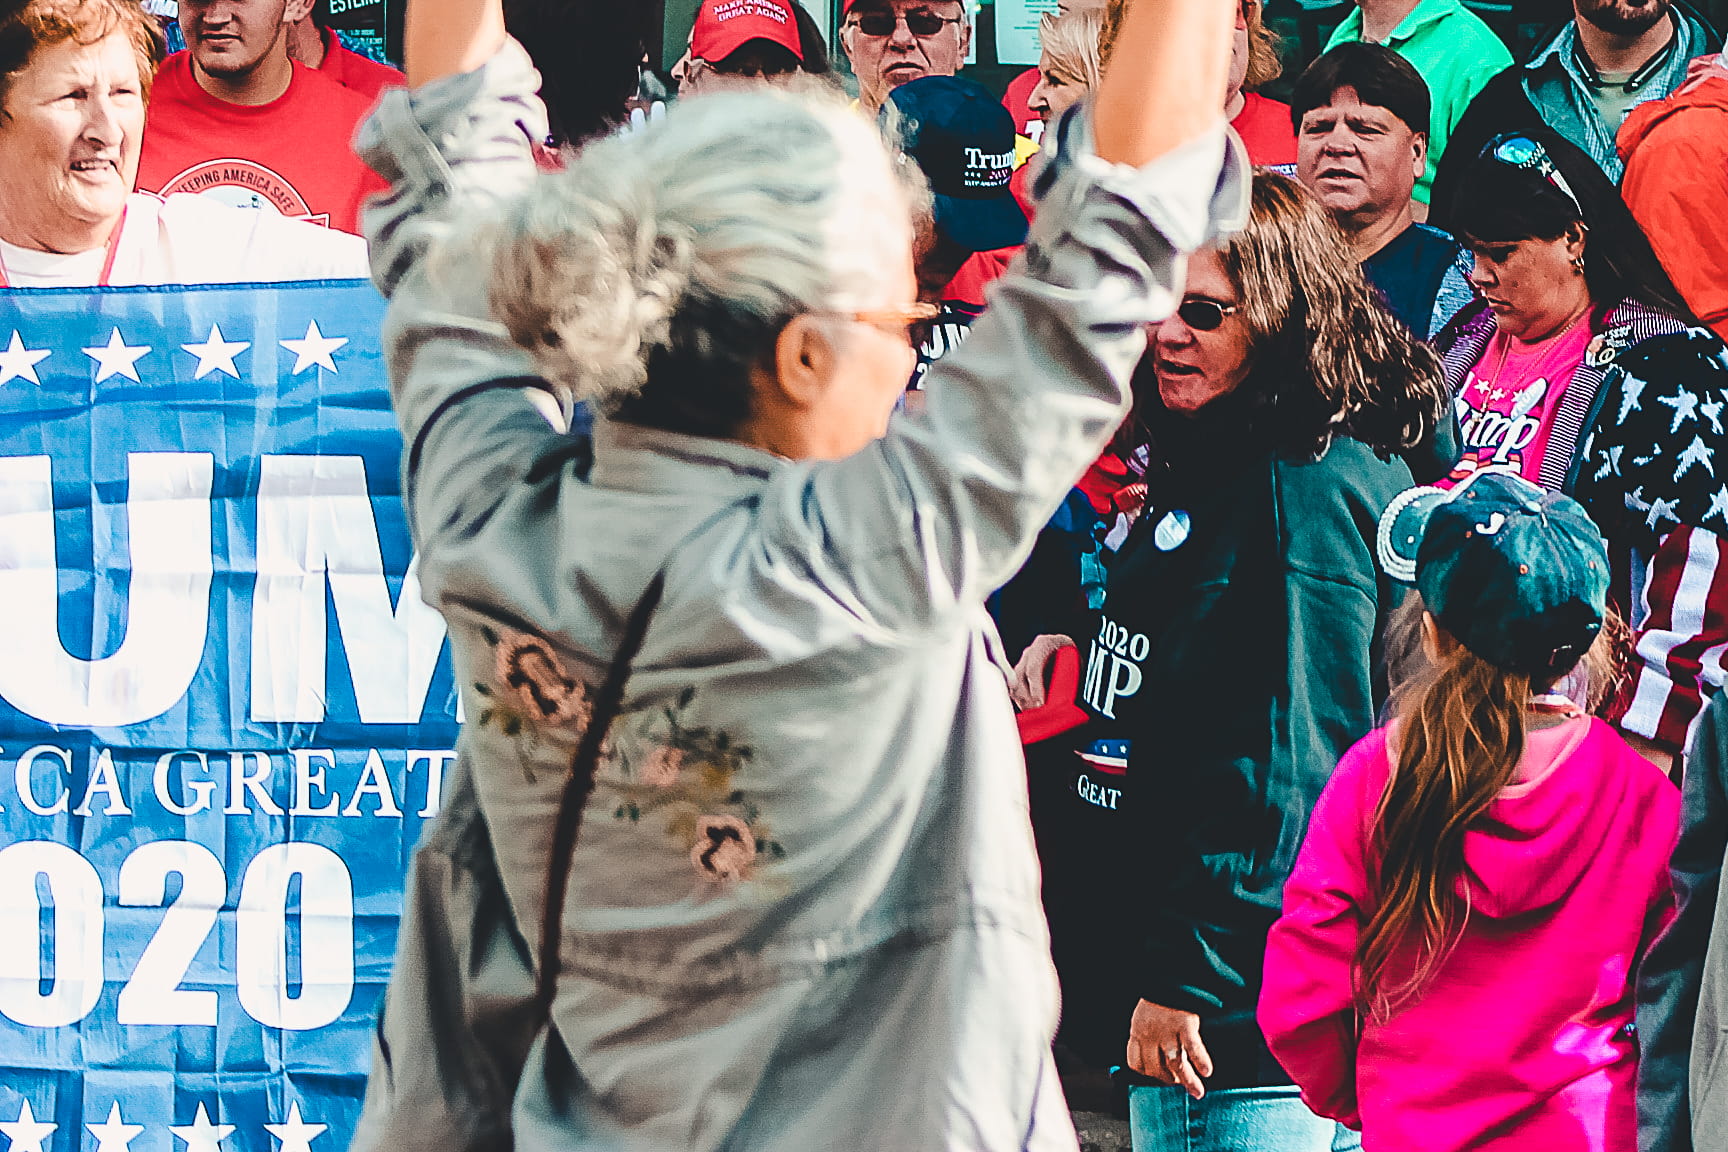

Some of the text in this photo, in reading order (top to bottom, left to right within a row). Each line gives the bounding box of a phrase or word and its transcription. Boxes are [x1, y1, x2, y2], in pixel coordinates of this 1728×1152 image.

[223, 168, 271, 192] AMERICA
[270, 186, 295, 212] SAFE
[0, 744, 458, 818] CA GREAT
